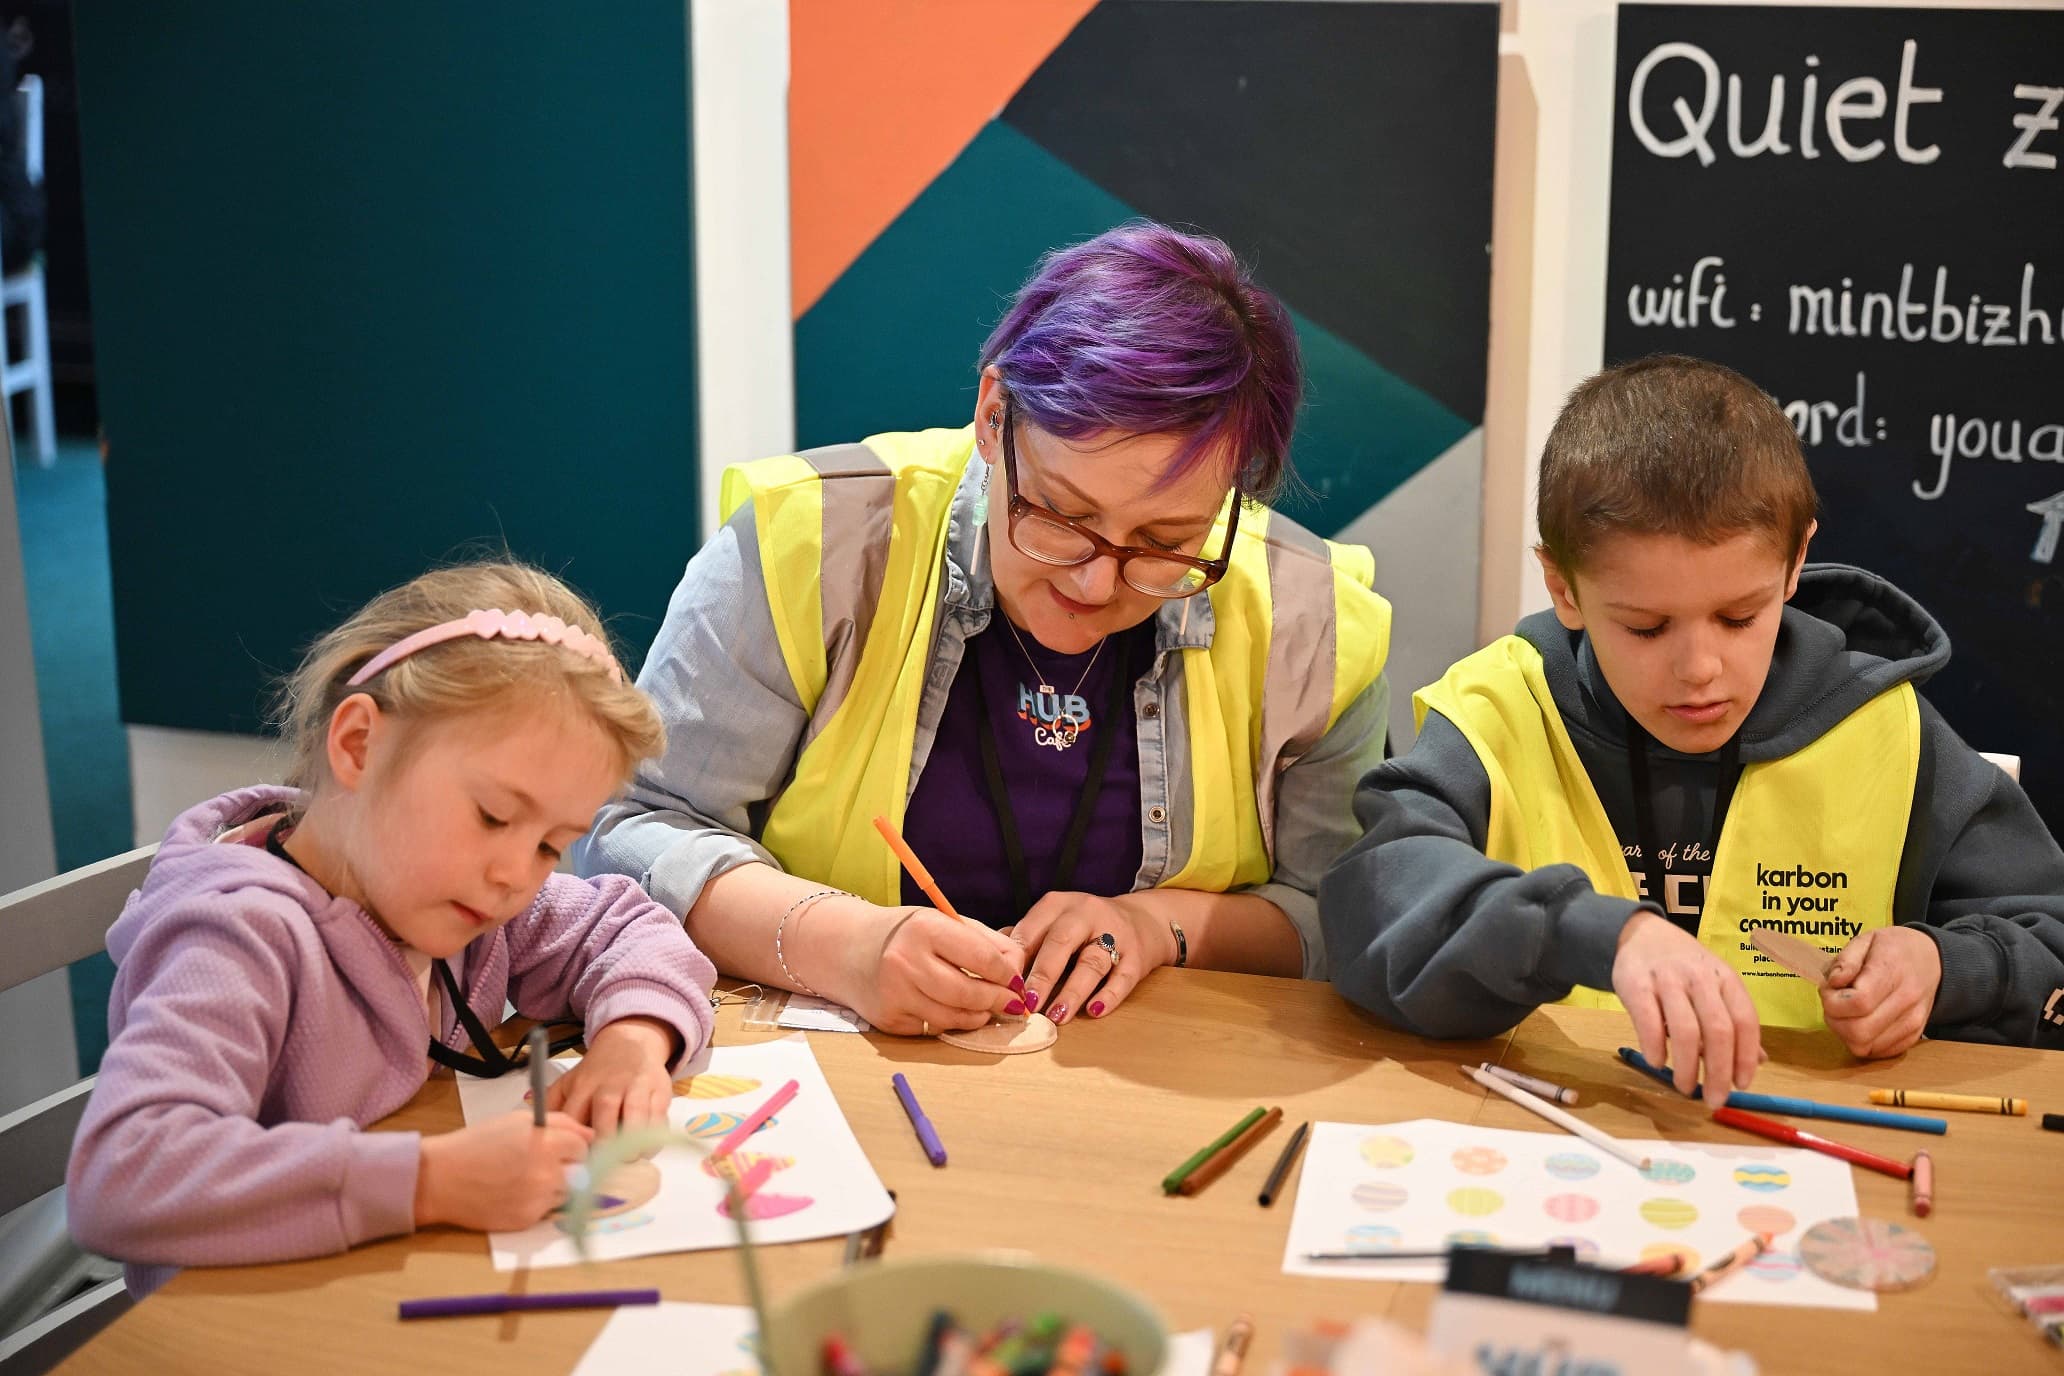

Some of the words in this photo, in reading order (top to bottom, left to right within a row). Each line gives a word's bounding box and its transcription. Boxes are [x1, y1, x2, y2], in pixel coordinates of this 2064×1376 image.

[1628, 39, 1943, 167] Quiet
[1789, 263, 2064, 345] mintbizh
[1775, 371, 1888, 447] ord:
[1018, 682, 1091, 726] HUB
[1621, 844, 1643, 858] ar
[1658, 842, 1677, 870] of
[1683, 842, 1711, 861] the
[1756, 863, 1848, 889] karbon
[1762, 890, 1781, 910] in
[1787, 896, 1838, 916] your
[1739, 916, 1863, 940] community
